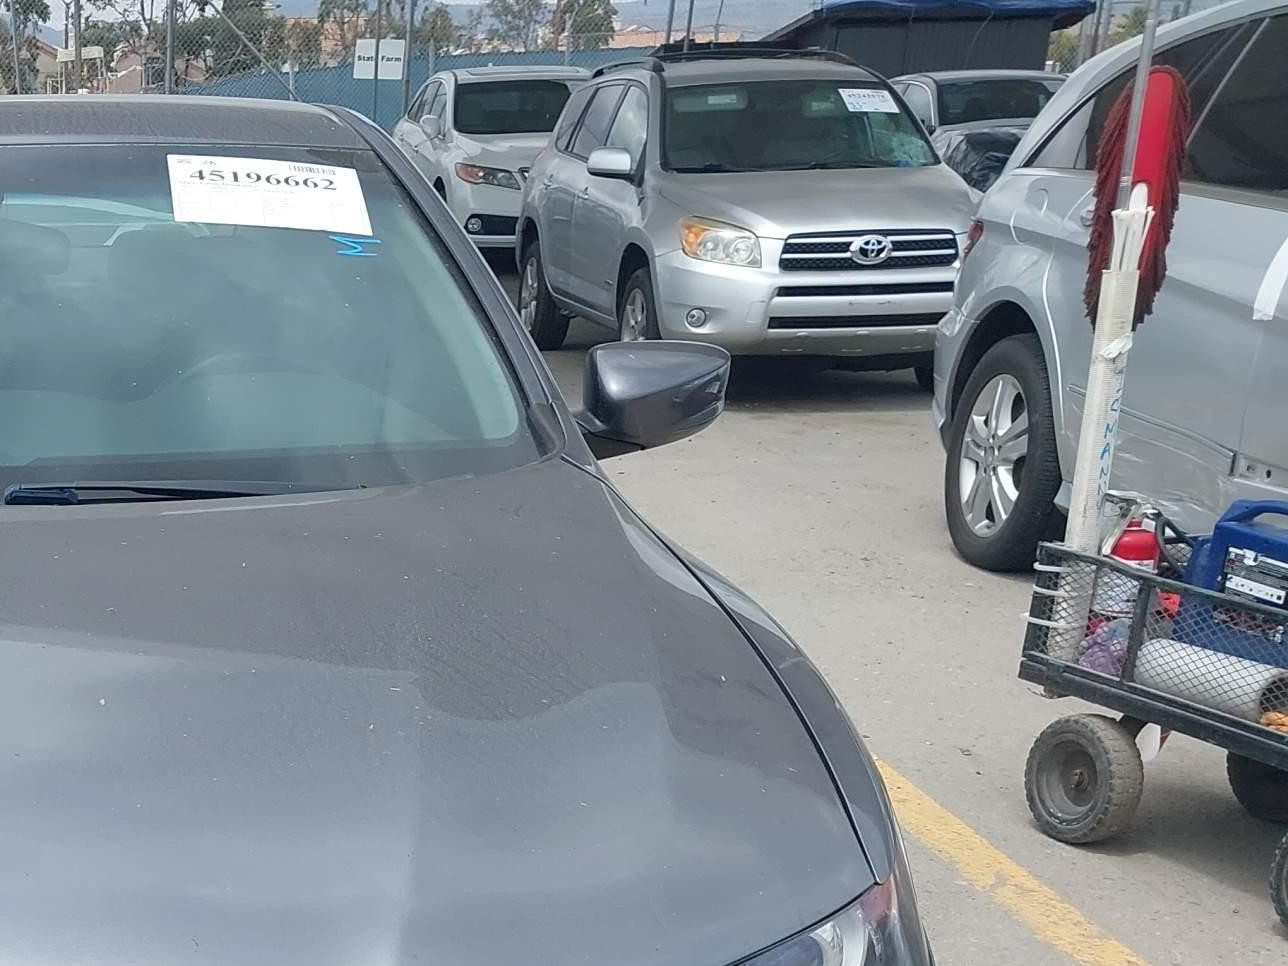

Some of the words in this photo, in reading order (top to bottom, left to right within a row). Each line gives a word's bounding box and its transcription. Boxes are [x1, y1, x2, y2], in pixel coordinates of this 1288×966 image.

[357, 54, 377, 62] Stat
[381, 55, 402, 63] Farm
[189, 169, 338, 191] 45196662
